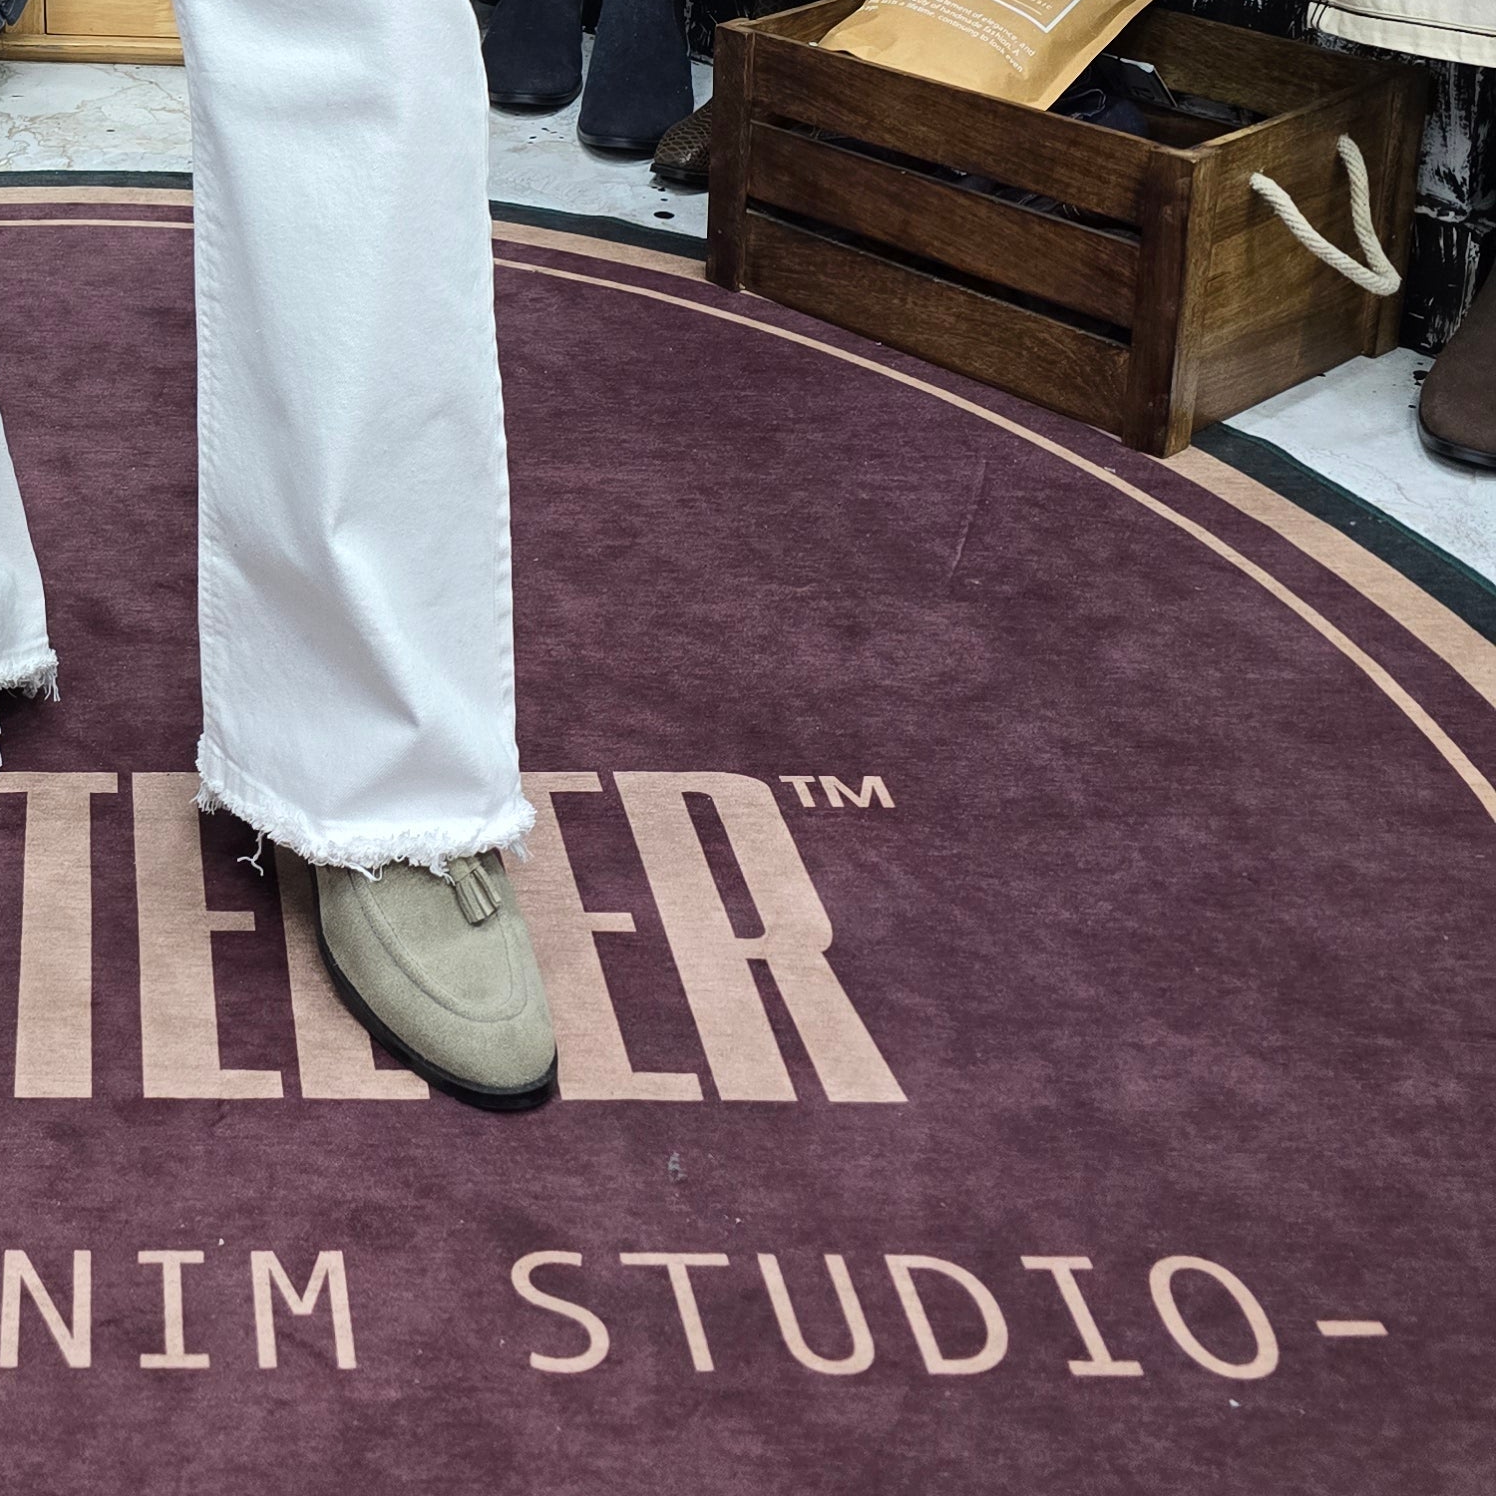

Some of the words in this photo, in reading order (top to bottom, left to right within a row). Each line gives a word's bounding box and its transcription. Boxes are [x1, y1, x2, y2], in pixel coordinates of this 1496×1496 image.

[939, 5, 983, 29] handmade
[979, 33, 989, 42] to
[989, 39, 1006, 55] look
[1005, 54, 1024, 73] even
[1019, 42, 1037, 57] and
